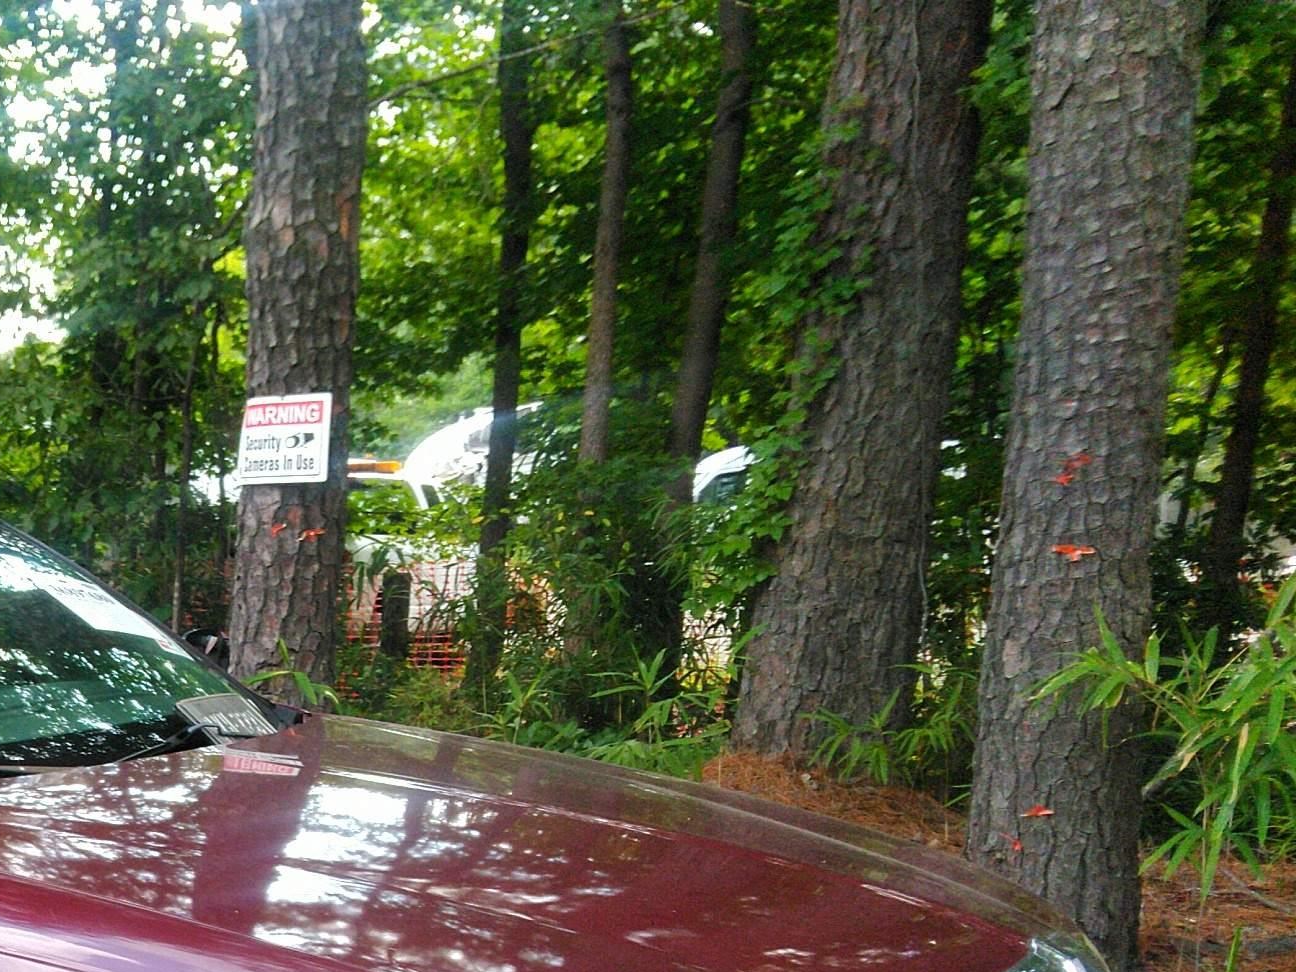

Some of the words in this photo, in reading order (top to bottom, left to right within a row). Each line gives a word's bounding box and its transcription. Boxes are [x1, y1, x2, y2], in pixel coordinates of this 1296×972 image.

[245, 403, 321, 427] WARNING
[245, 434, 281, 453] Security
[244, 457, 280, 472] Cameras
[283, 455, 293, 470] In
[296, 454, 315, 470] Use
